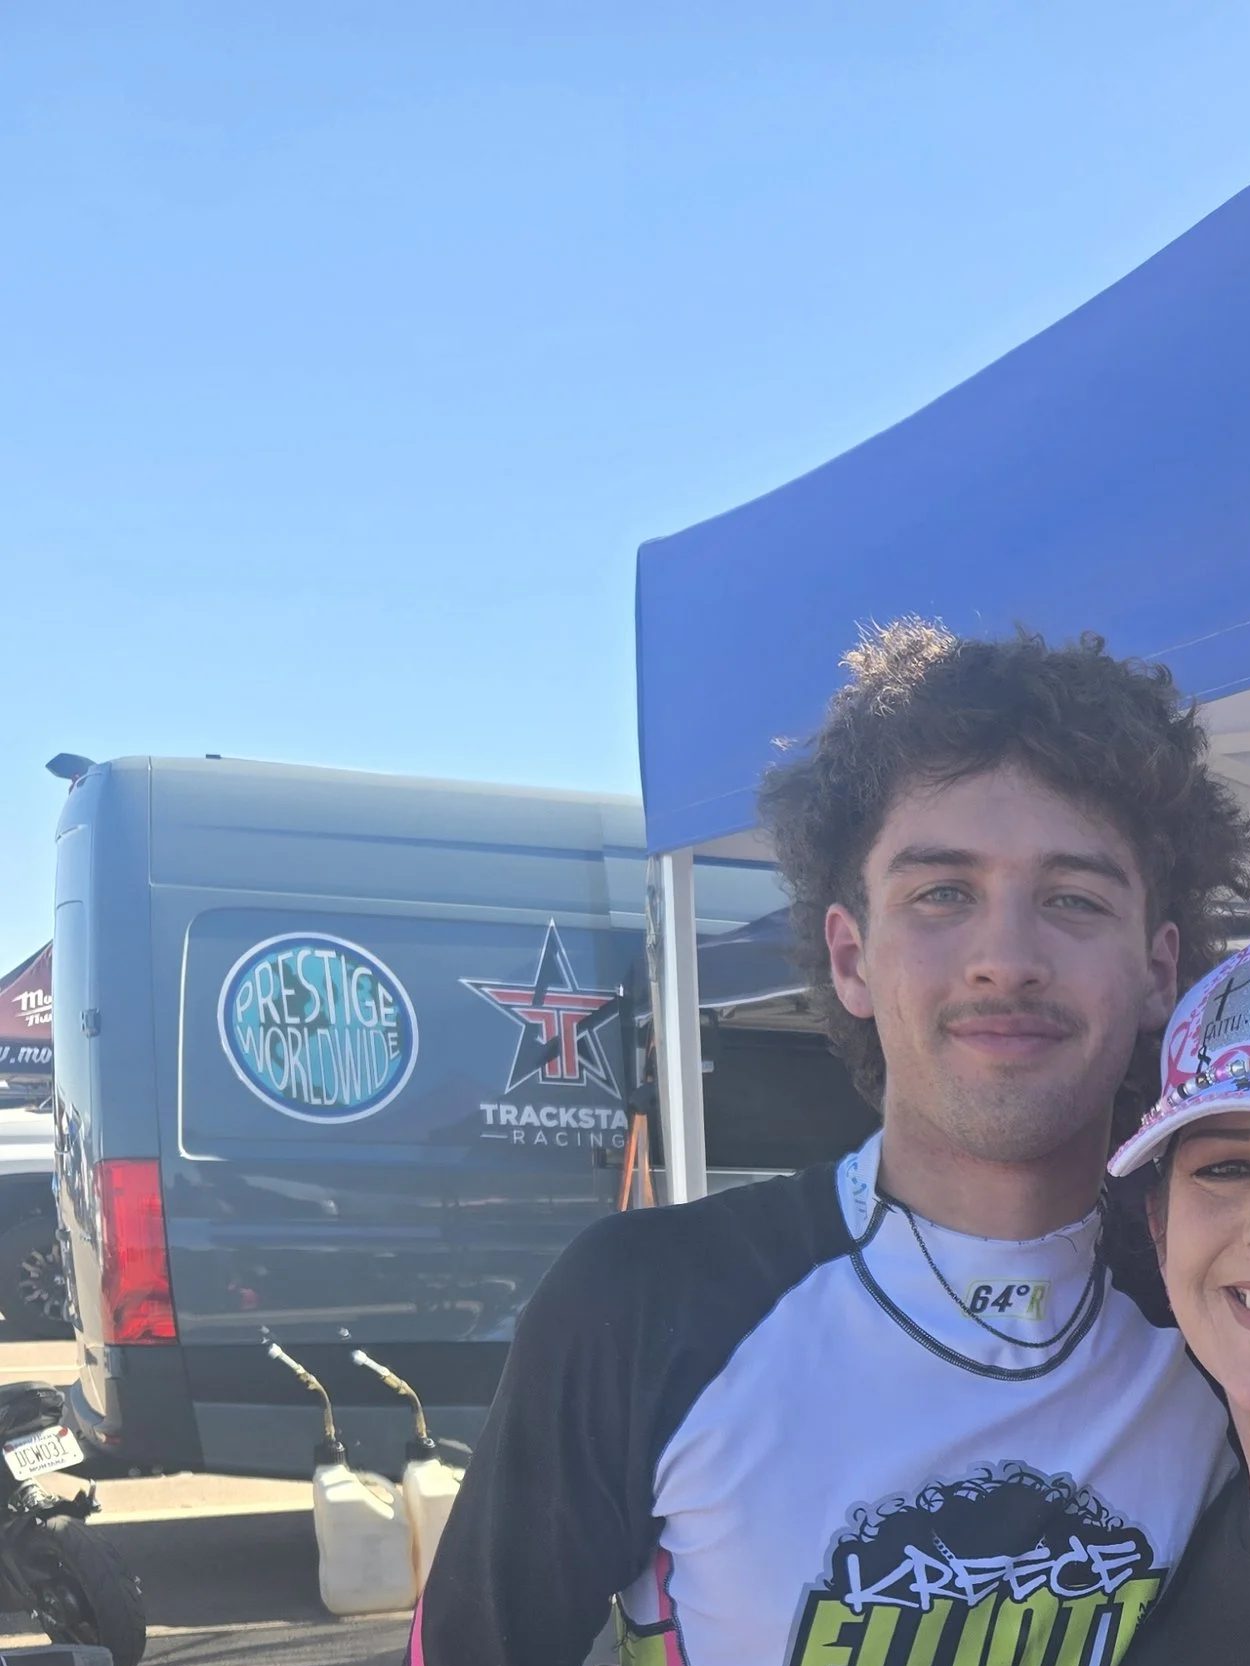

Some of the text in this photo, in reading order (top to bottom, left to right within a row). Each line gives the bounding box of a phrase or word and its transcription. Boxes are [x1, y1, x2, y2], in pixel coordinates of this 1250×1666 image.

[236, 949, 397, 1027] PRESTIGE
[1202, 1013, 1242, 1045] FAITH
[235, 1025, 400, 1105] WORLDWIDE
[480, 1104, 629, 1130] TRACKSTA
[512, 1129, 626, 1148] RACING
[845, 1535, 1142, 1613] KREECE
